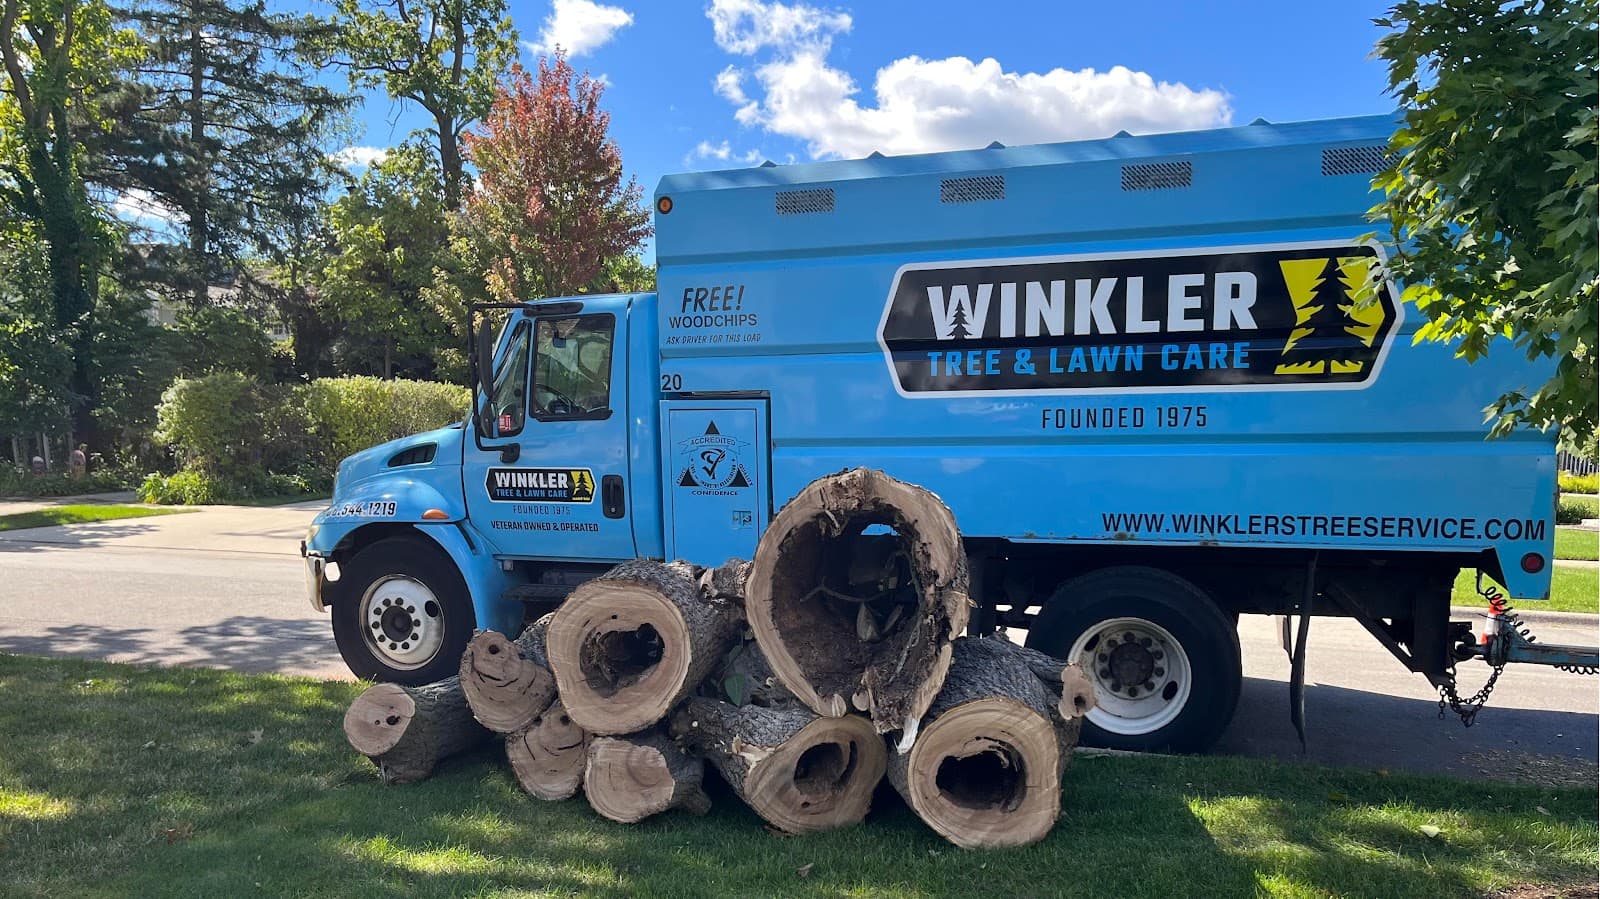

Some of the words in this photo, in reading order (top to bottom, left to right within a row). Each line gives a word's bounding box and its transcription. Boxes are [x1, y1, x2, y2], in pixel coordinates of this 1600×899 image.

[681, 285, 744, 313] FREE!
[927, 271, 1257, 340] WINKLER
[669, 313, 757, 328] WOODCHIPS
[666, 335, 680, 345] ASK
[682, 335, 707, 345] DRIVER
[709, 334, 724, 344] FOR
[725, 334, 741, 343] THIS
[743, 333, 761, 342] LOAD
[928, 350, 1000, 377] TREE
[1013, 348, 1036, 376] &
[1049, 344, 1143, 374] LAWN
[1161, 341, 1250, 371] CARE
[661, 374, 682, 391] 20
[1042, 408, 1145, 429] FOUNDED
[1156, 406, 1208, 428] 1975
[691, 437, 736, 446] ACCREDITED
[495, 472, 569, 489] WINKLER
[496, 488, 514, 497] TREE
[516, 489, 522, 497] &
[523, 489, 545, 497] LAWN
[548, 489, 568, 498] CARE
[513, 505, 550, 515] FOUNDED
[491, 521, 523, 530] VETERAN
[524, 522, 550, 531] OWNED
[552, 523, 559, 531] &
[560, 522, 599, 532] OPERATED
[1102, 513, 1545, 541] WWW.WINKLERSTREESERVICE.COM
